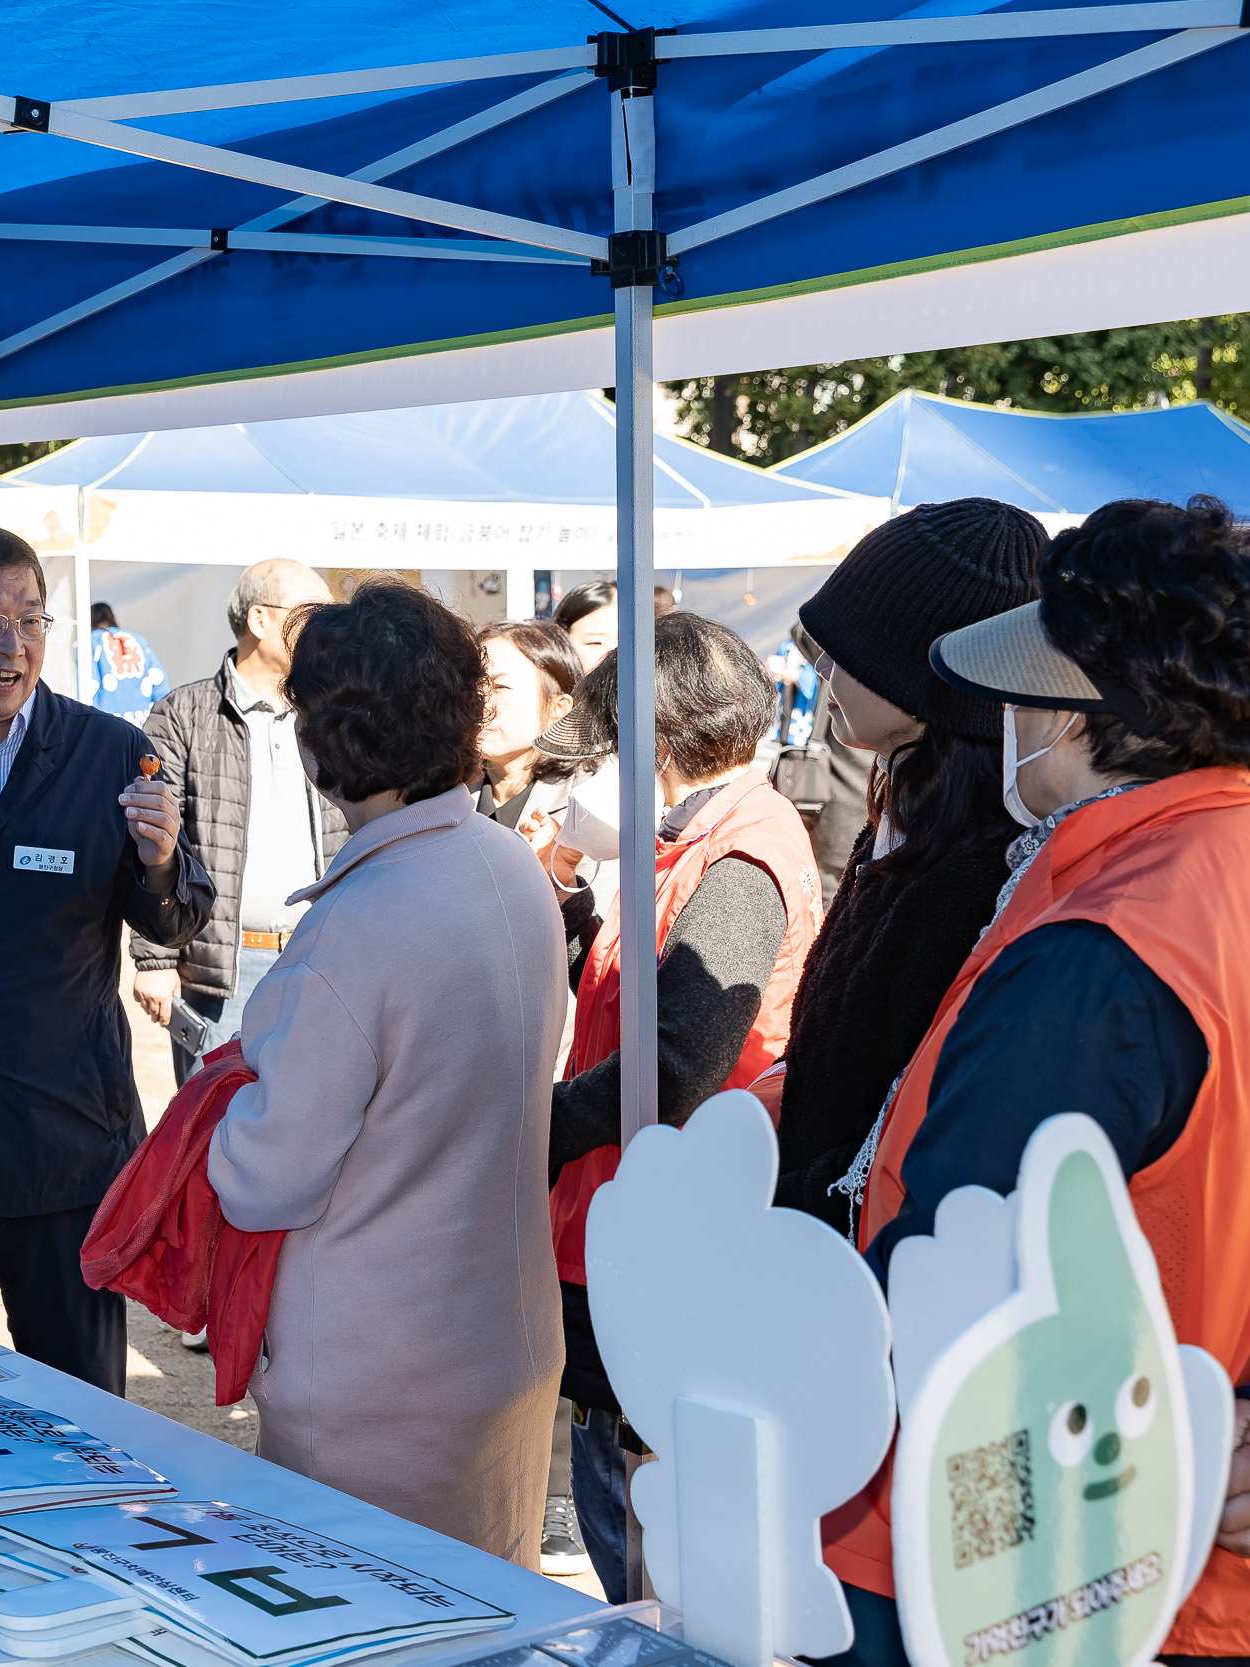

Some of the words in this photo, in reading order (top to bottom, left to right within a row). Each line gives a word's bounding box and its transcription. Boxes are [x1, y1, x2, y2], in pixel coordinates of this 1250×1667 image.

[229, 1533, 338, 1571] 단어는?
[239, 1523, 352, 1559] 초성으로
[339, 1561, 456, 1608] 시작되는
